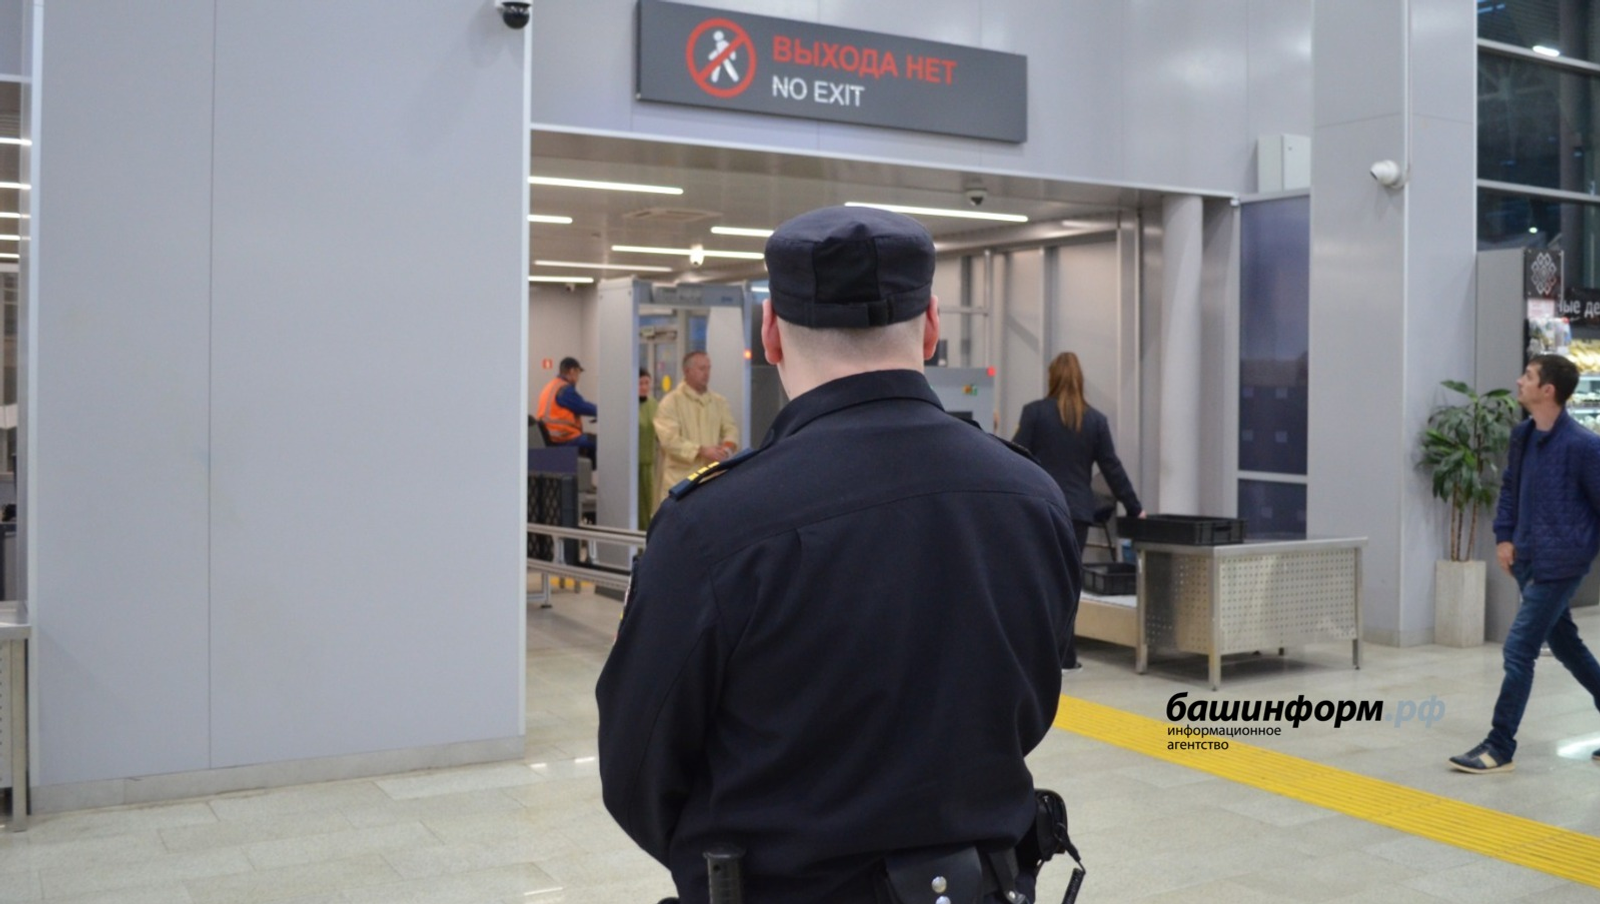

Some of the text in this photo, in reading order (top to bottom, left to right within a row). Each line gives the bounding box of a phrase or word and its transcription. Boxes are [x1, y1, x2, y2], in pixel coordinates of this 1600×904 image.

[772, 35, 957, 85] ВЫХОДА НЕТ
[771, 75, 866, 107] NO EXIT
